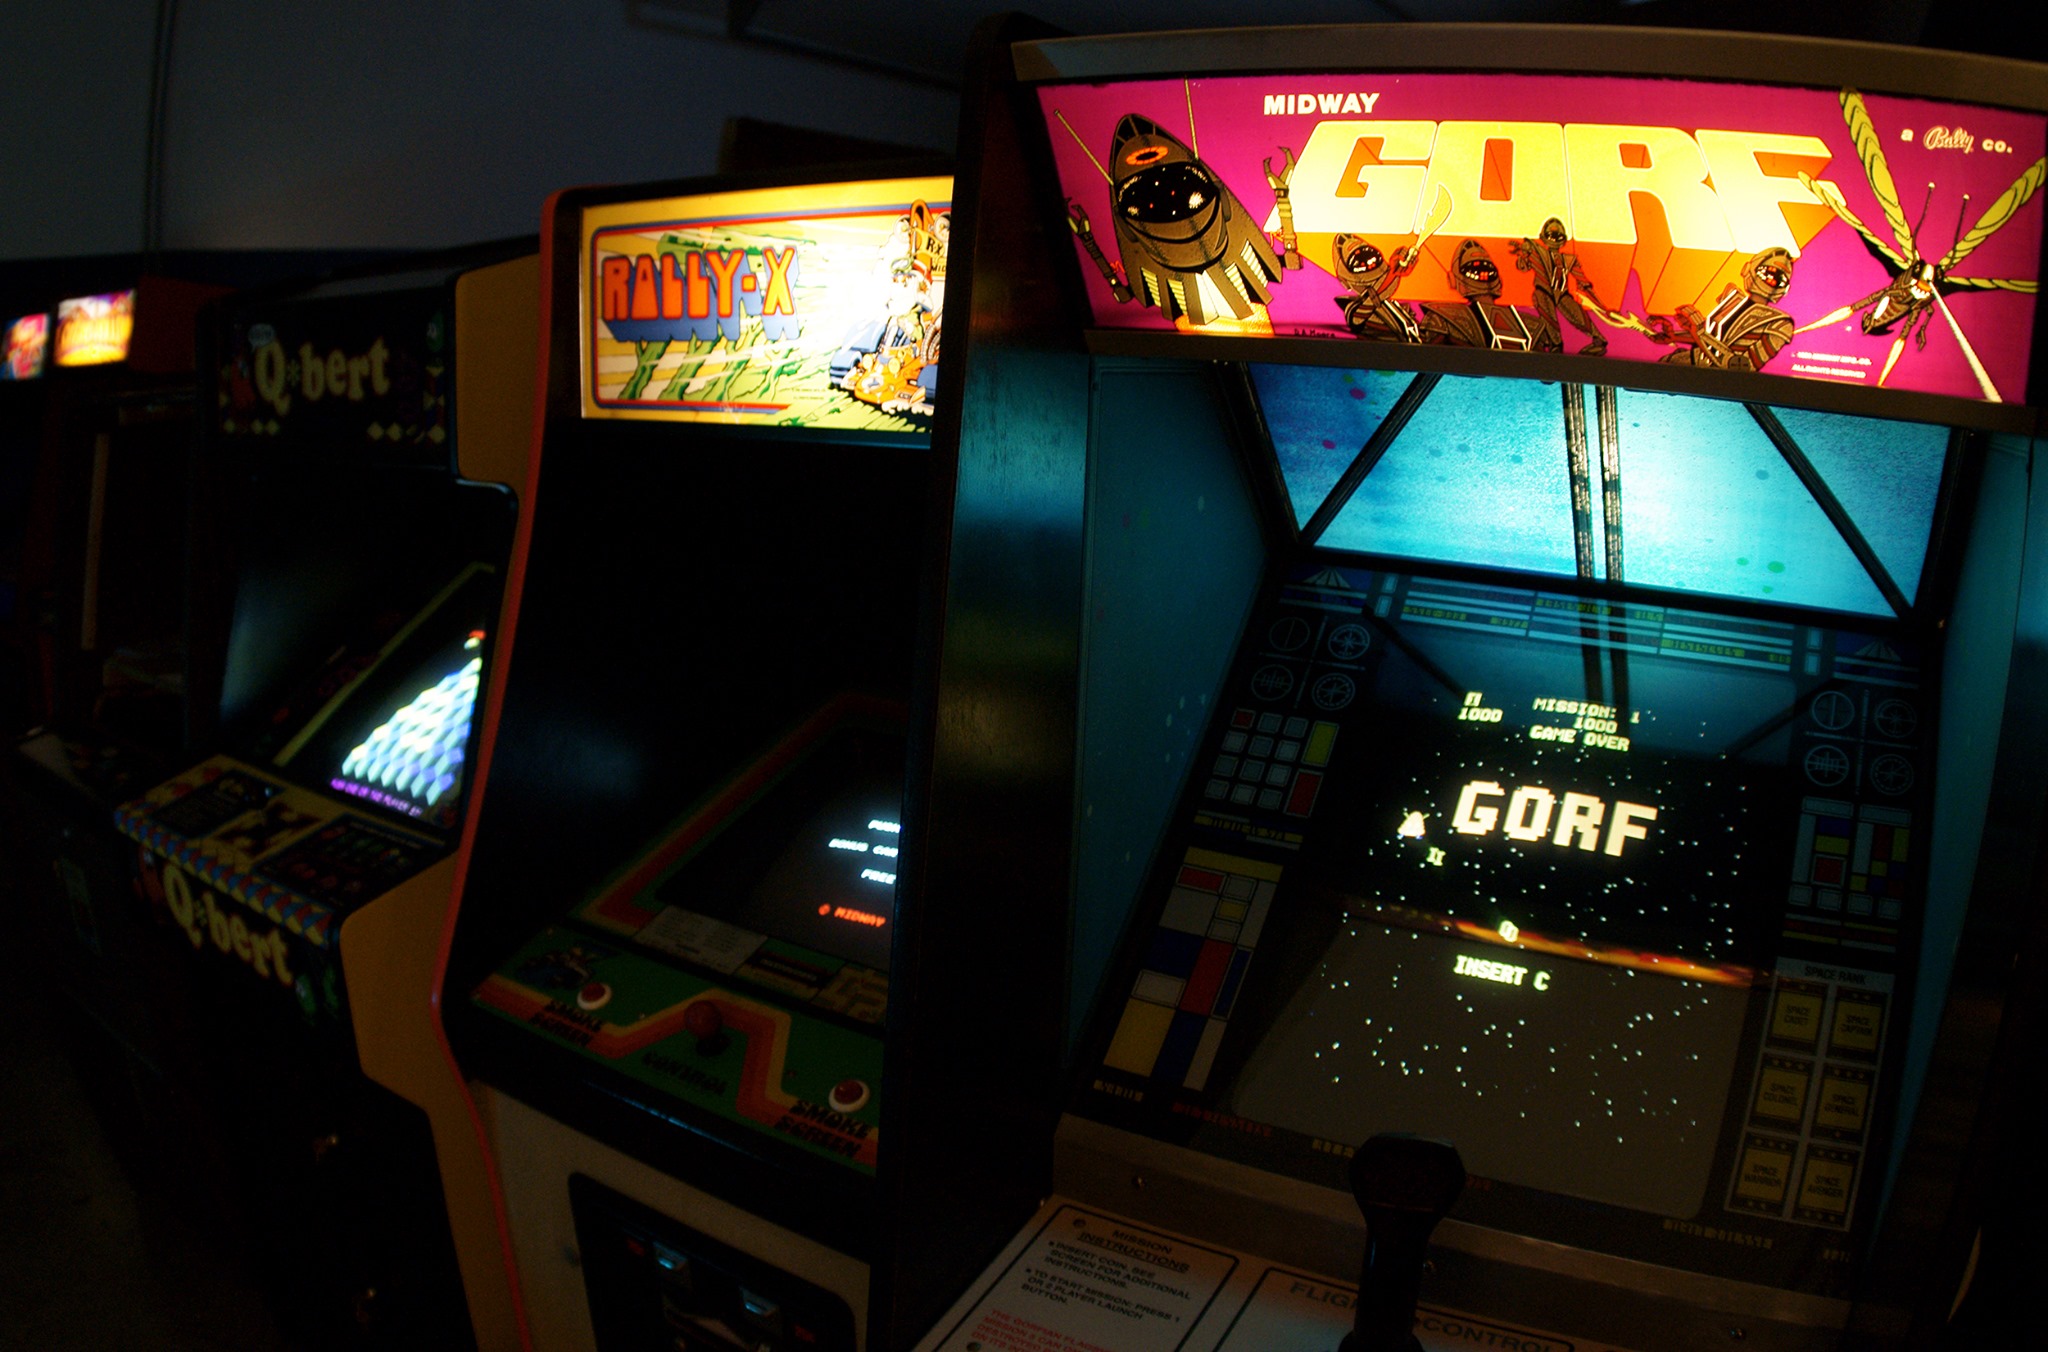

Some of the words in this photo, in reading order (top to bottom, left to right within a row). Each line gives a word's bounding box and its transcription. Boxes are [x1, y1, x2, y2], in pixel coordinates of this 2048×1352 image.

[1263, 92, 1380, 116] MIDWAY
[1900, 128, 1914, 142] a
[1923, 125, 1975, 155] Bally
[1981, 138, 2013, 154] co.
[1264, 119, 1847, 258] GORF
[602, 247, 797, 322] RALLY-X
[1458, 707, 1503, 723] 1000
[1532, 697, 1617, 719] MISSION:
[1529, 724, 1577, 744] GAME
[1583, 732, 1630, 752] OVER
[1573, 716, 1618, 734] 1000
[1451, 780, 1658, 857] GORF
[833, 906, 887, 928] MIDWAY
[1454, 955, 1528, 986] INSERT
[1533, 971, 1551, 991] C
[1805, 966, 1836, 979] SPACE
[1840, 971, 1866, 985] RANK
[1055, 1242, 1097, 1260] INSERT
[1079, 1231, 1190, 1272] INSTRUCTIONS
[1112, 1229, 1172, 1254] MISSION
[1050, 1250, 1101, 1272] SCREEN
[1100, 1264, 1121, 1277] FOR
[1123, 1273, 1191, 1300] ADDITIONAL
[1028, 1277, 1045, 1287] OR
[1053, 1286, 1097, 1305] PLAYER
[1098, 1300, 1144, 1320] LAUNCH
[1035, 1269, 1048, 1280] TO
[1050, 1274, 1083, 1291] START
[1135, 1303, 1172, 1321] PRESS
[1290, 1281, 1359, 1309] FLIG
